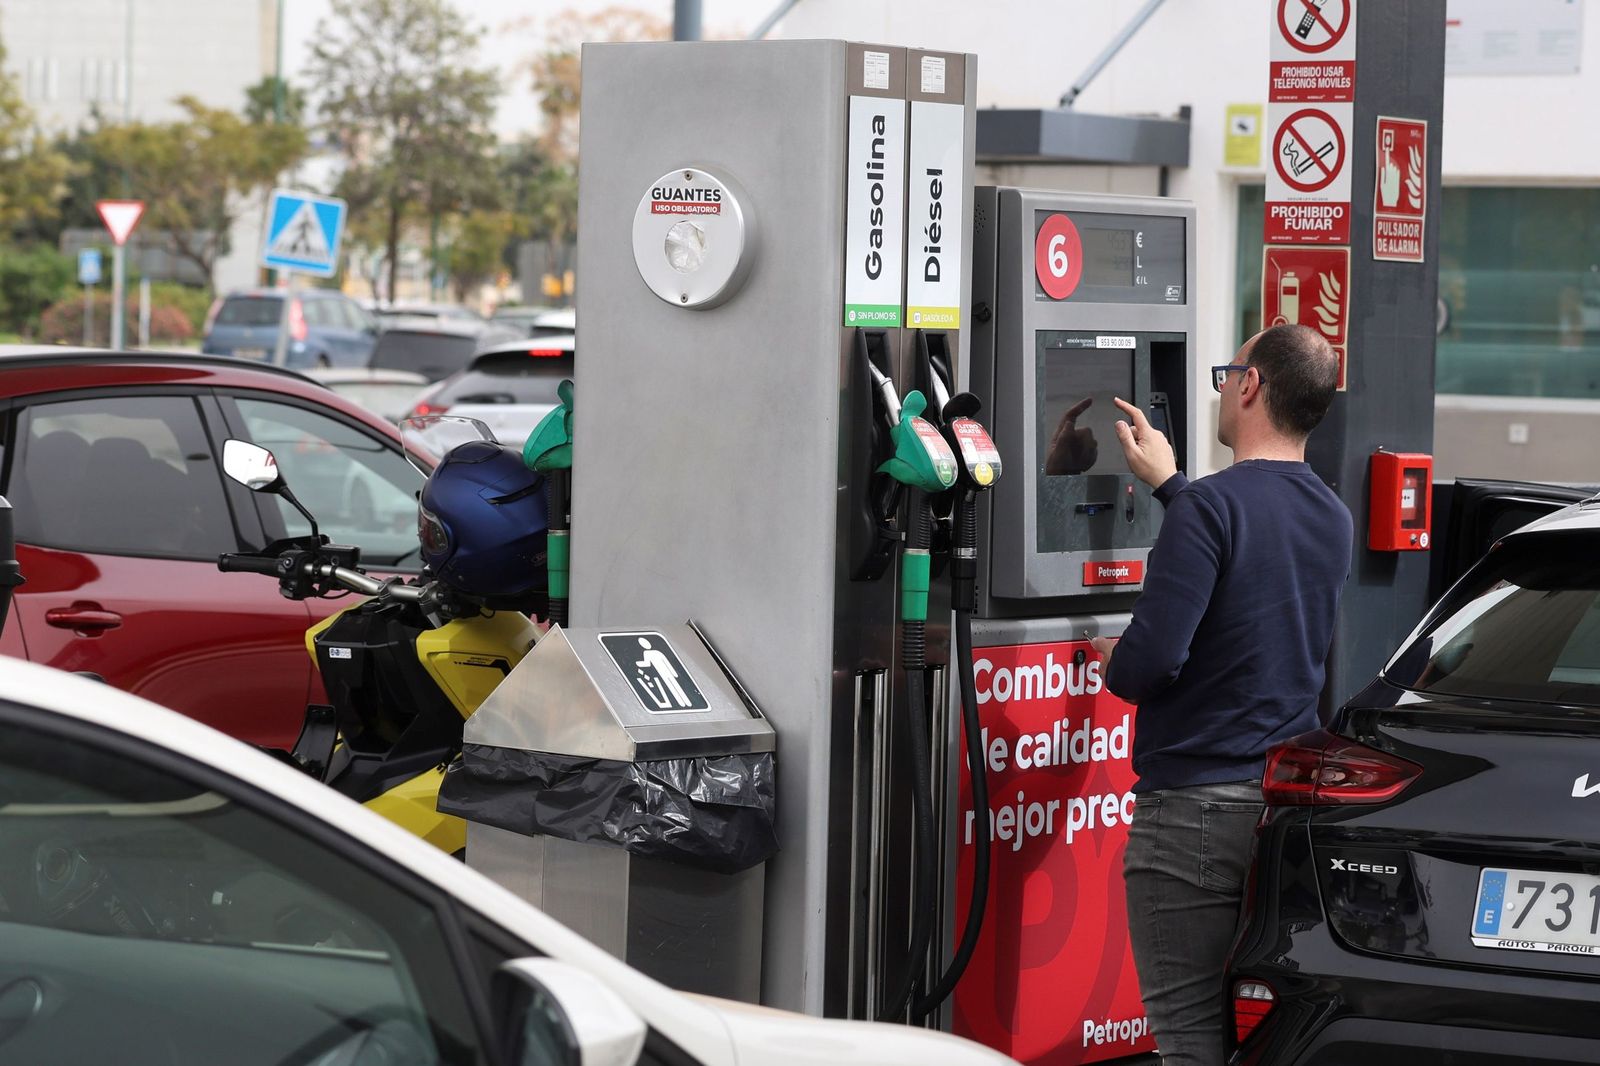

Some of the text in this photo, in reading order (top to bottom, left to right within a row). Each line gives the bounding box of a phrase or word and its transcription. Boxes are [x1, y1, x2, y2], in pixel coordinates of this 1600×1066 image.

[1281, 66, 1344, 77] PROHIBIDO USAR
[1273, 77, 1351, 89] TELEFONOS MOVILES
[651, 187, 722, 202] GUANTES
[865, 115, 885, 281] Gasolina
[671, 205, 718, 213] OBLIGATORIO
[1271, 206, 1344, 218] PROHIBIDO
[924, 168, 943, 282] Diésel
[1284, 218, 1333, 230] FUMAR
[1378, 221, 1420, 238] PULSADOR
[1136, 232, 1143, 248] €
[1378, 238, 1419, 254] DE ALARMA
[1048, 234, 1069, 278] 6
[1136, 255, 1142, 269] L
[858, 312, 897, 320] SIN PLOMO 95
[1098, 565, 1129, 579] Petroprix
[973, 653, 1111, 704] Combus
[1015, 714, 1130, 770] calidad
[1330, 858, 1398, 875] XCEED
[1483, 909, 1495, 924] E
[1497, 940, 1595, 953] AUTOS PARQUE
